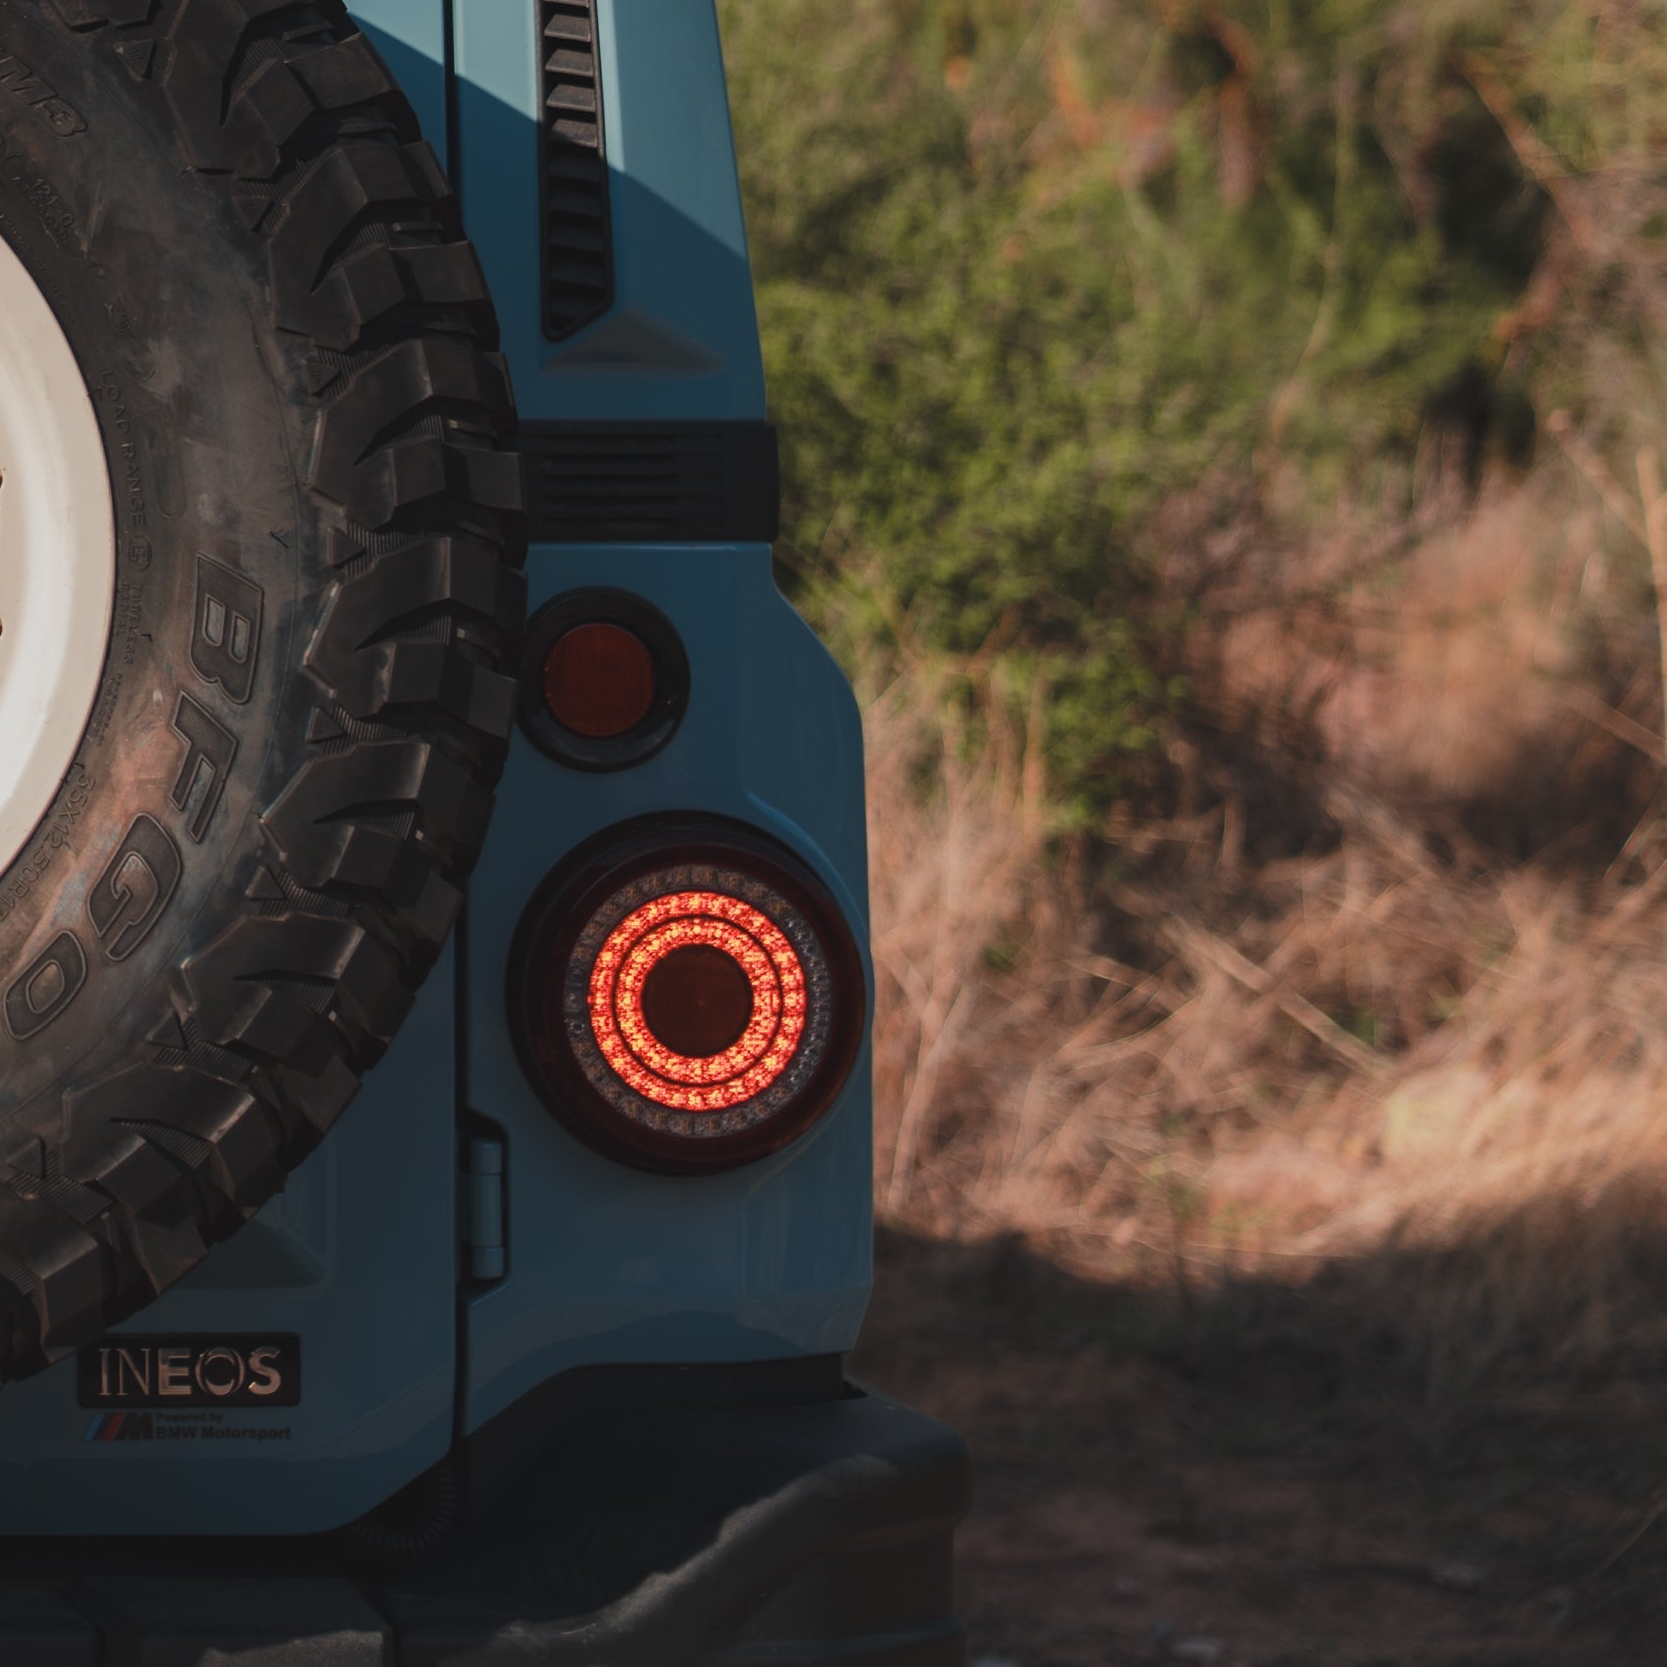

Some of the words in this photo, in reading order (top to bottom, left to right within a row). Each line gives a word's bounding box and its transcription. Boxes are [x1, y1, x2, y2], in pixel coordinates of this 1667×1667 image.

[101, 371, 129, 430] LOAD
[120, 442, 144, 526] RANGE
[98, 1347, 282, 1396] INEOS
[155, 1413, 206, 1422] Powered
[208, 1413, 223, 1423] by
[156, 1428, 196, 1439] BMW
[201, 1427, 291, 1440] Motorsport
